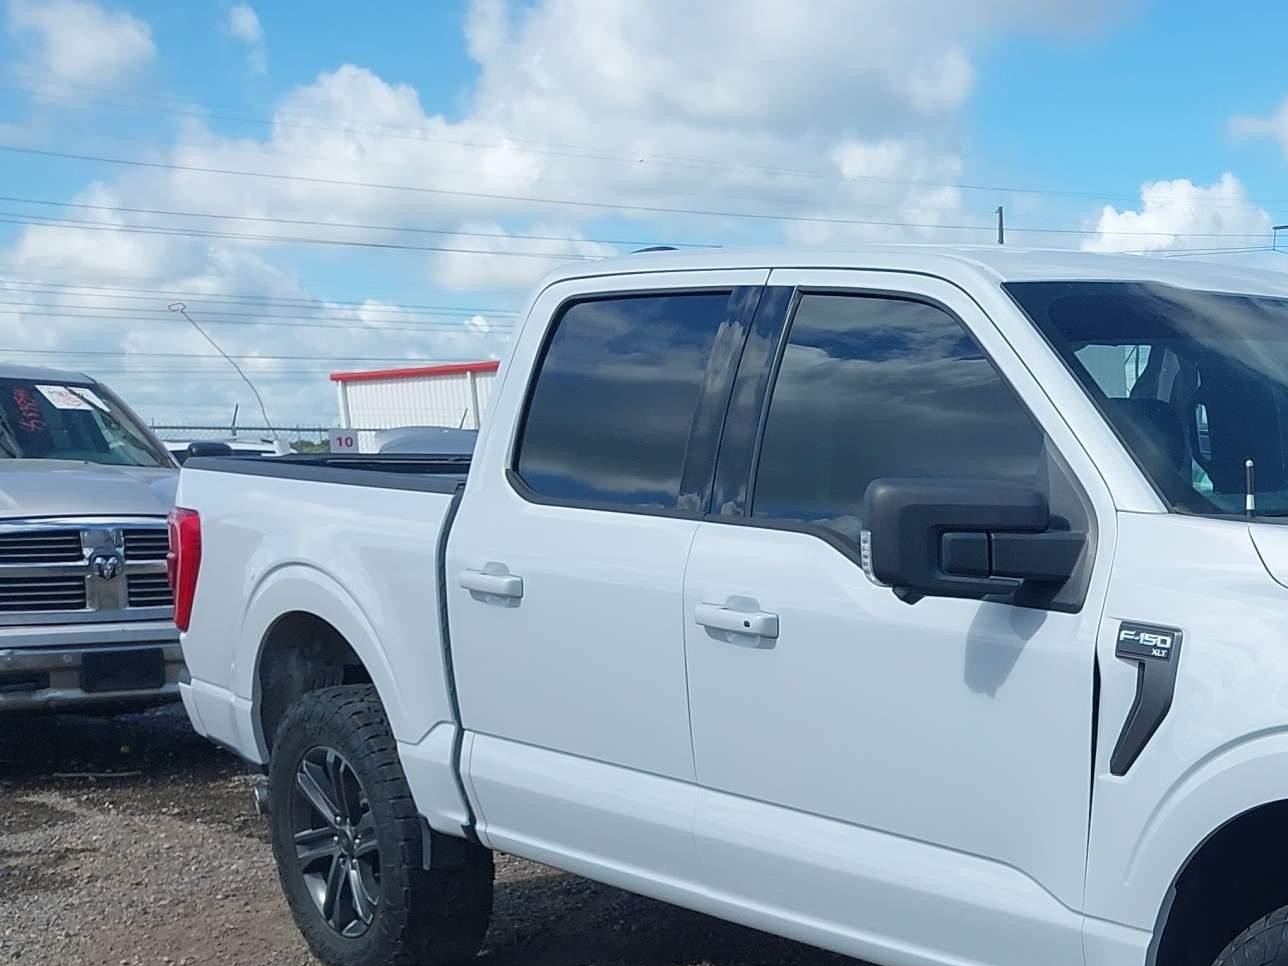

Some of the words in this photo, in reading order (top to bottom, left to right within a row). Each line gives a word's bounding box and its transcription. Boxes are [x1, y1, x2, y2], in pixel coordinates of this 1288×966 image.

[335, 436, 353, 448] 10
[1119, 630, 1172, 648] F-150
[1151, 648, 1168, 657] XLT
